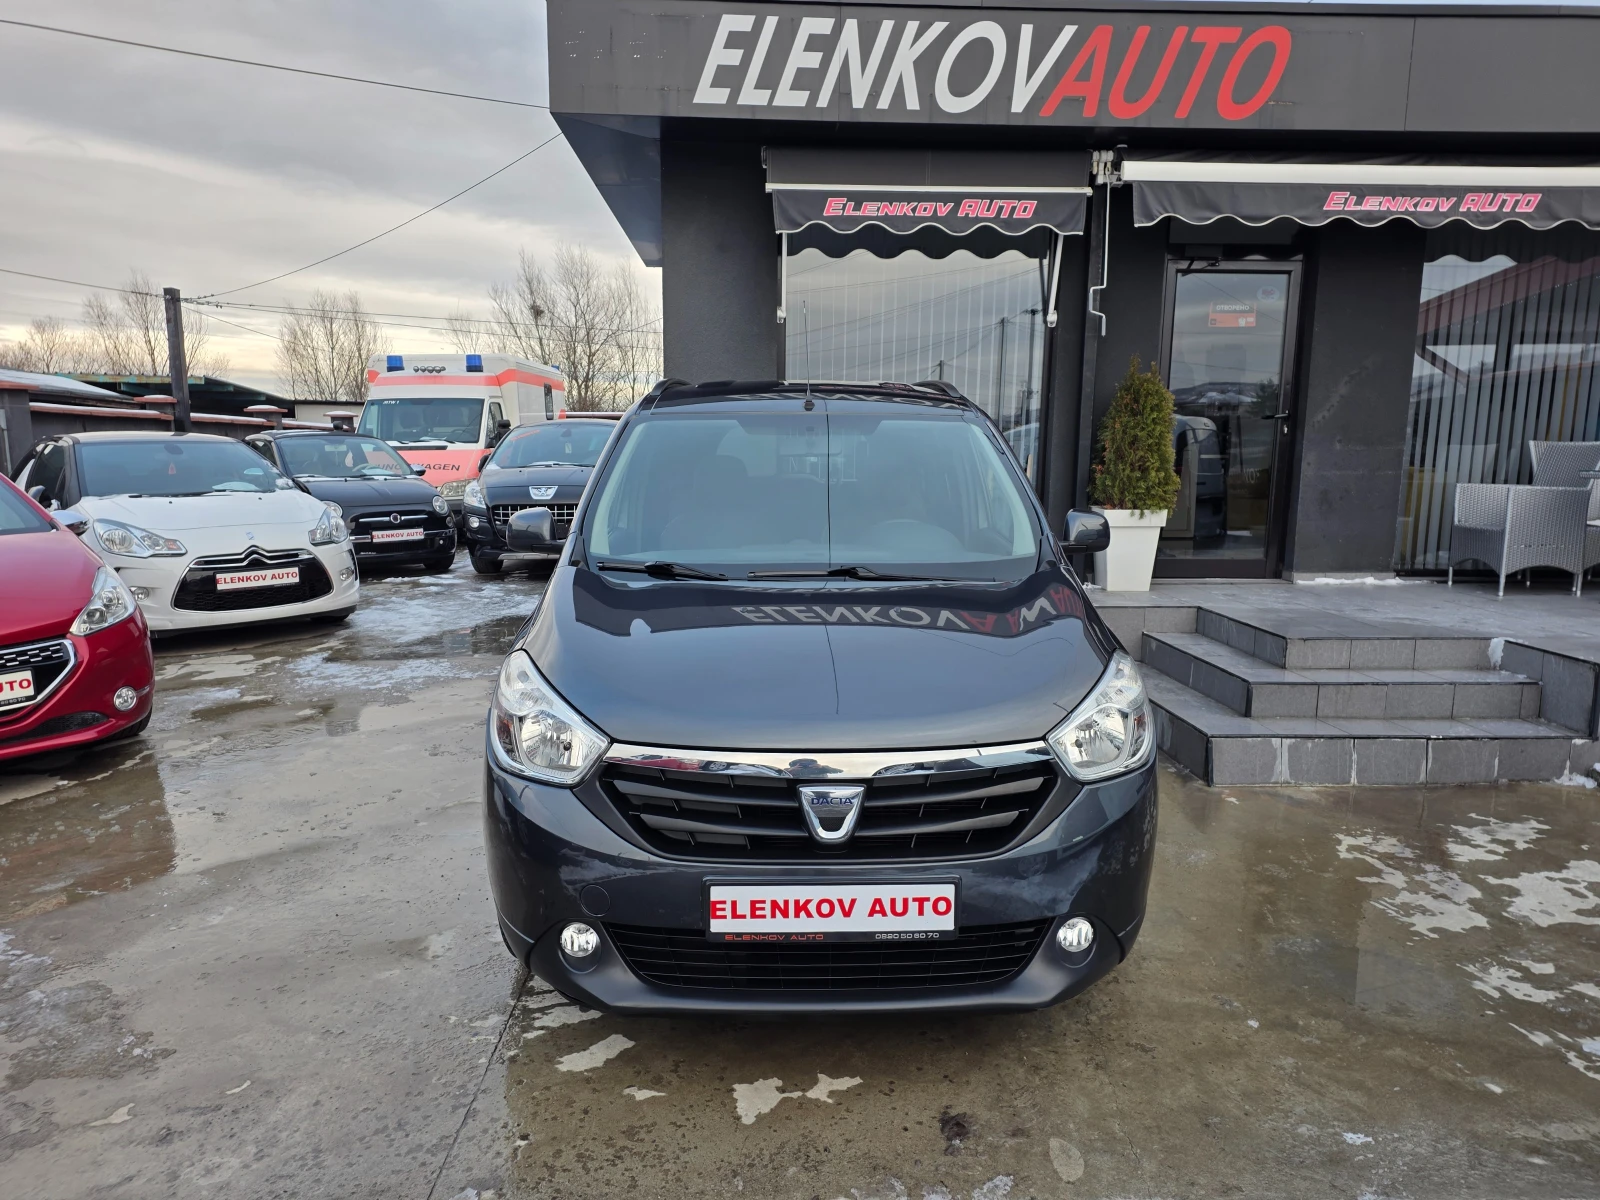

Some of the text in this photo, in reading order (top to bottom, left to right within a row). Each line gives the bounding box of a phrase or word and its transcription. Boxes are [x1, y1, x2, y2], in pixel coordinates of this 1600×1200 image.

[692, 14, 1292, 120] ELENKOV AUTO
[823, 197, 1038, 218] ELENKOV AUTO
[1323, 191, 1542, 213] ELENKOV AUTO
[372, 532, 404, 540] ELENKOV
[216, 574, 267, 585] ELENKOV
[271, 571, 298, 580] AUTO
[811, 797, 853, 805] DACIA
[710, 896, 952, 920] ELENKOV AUTO
